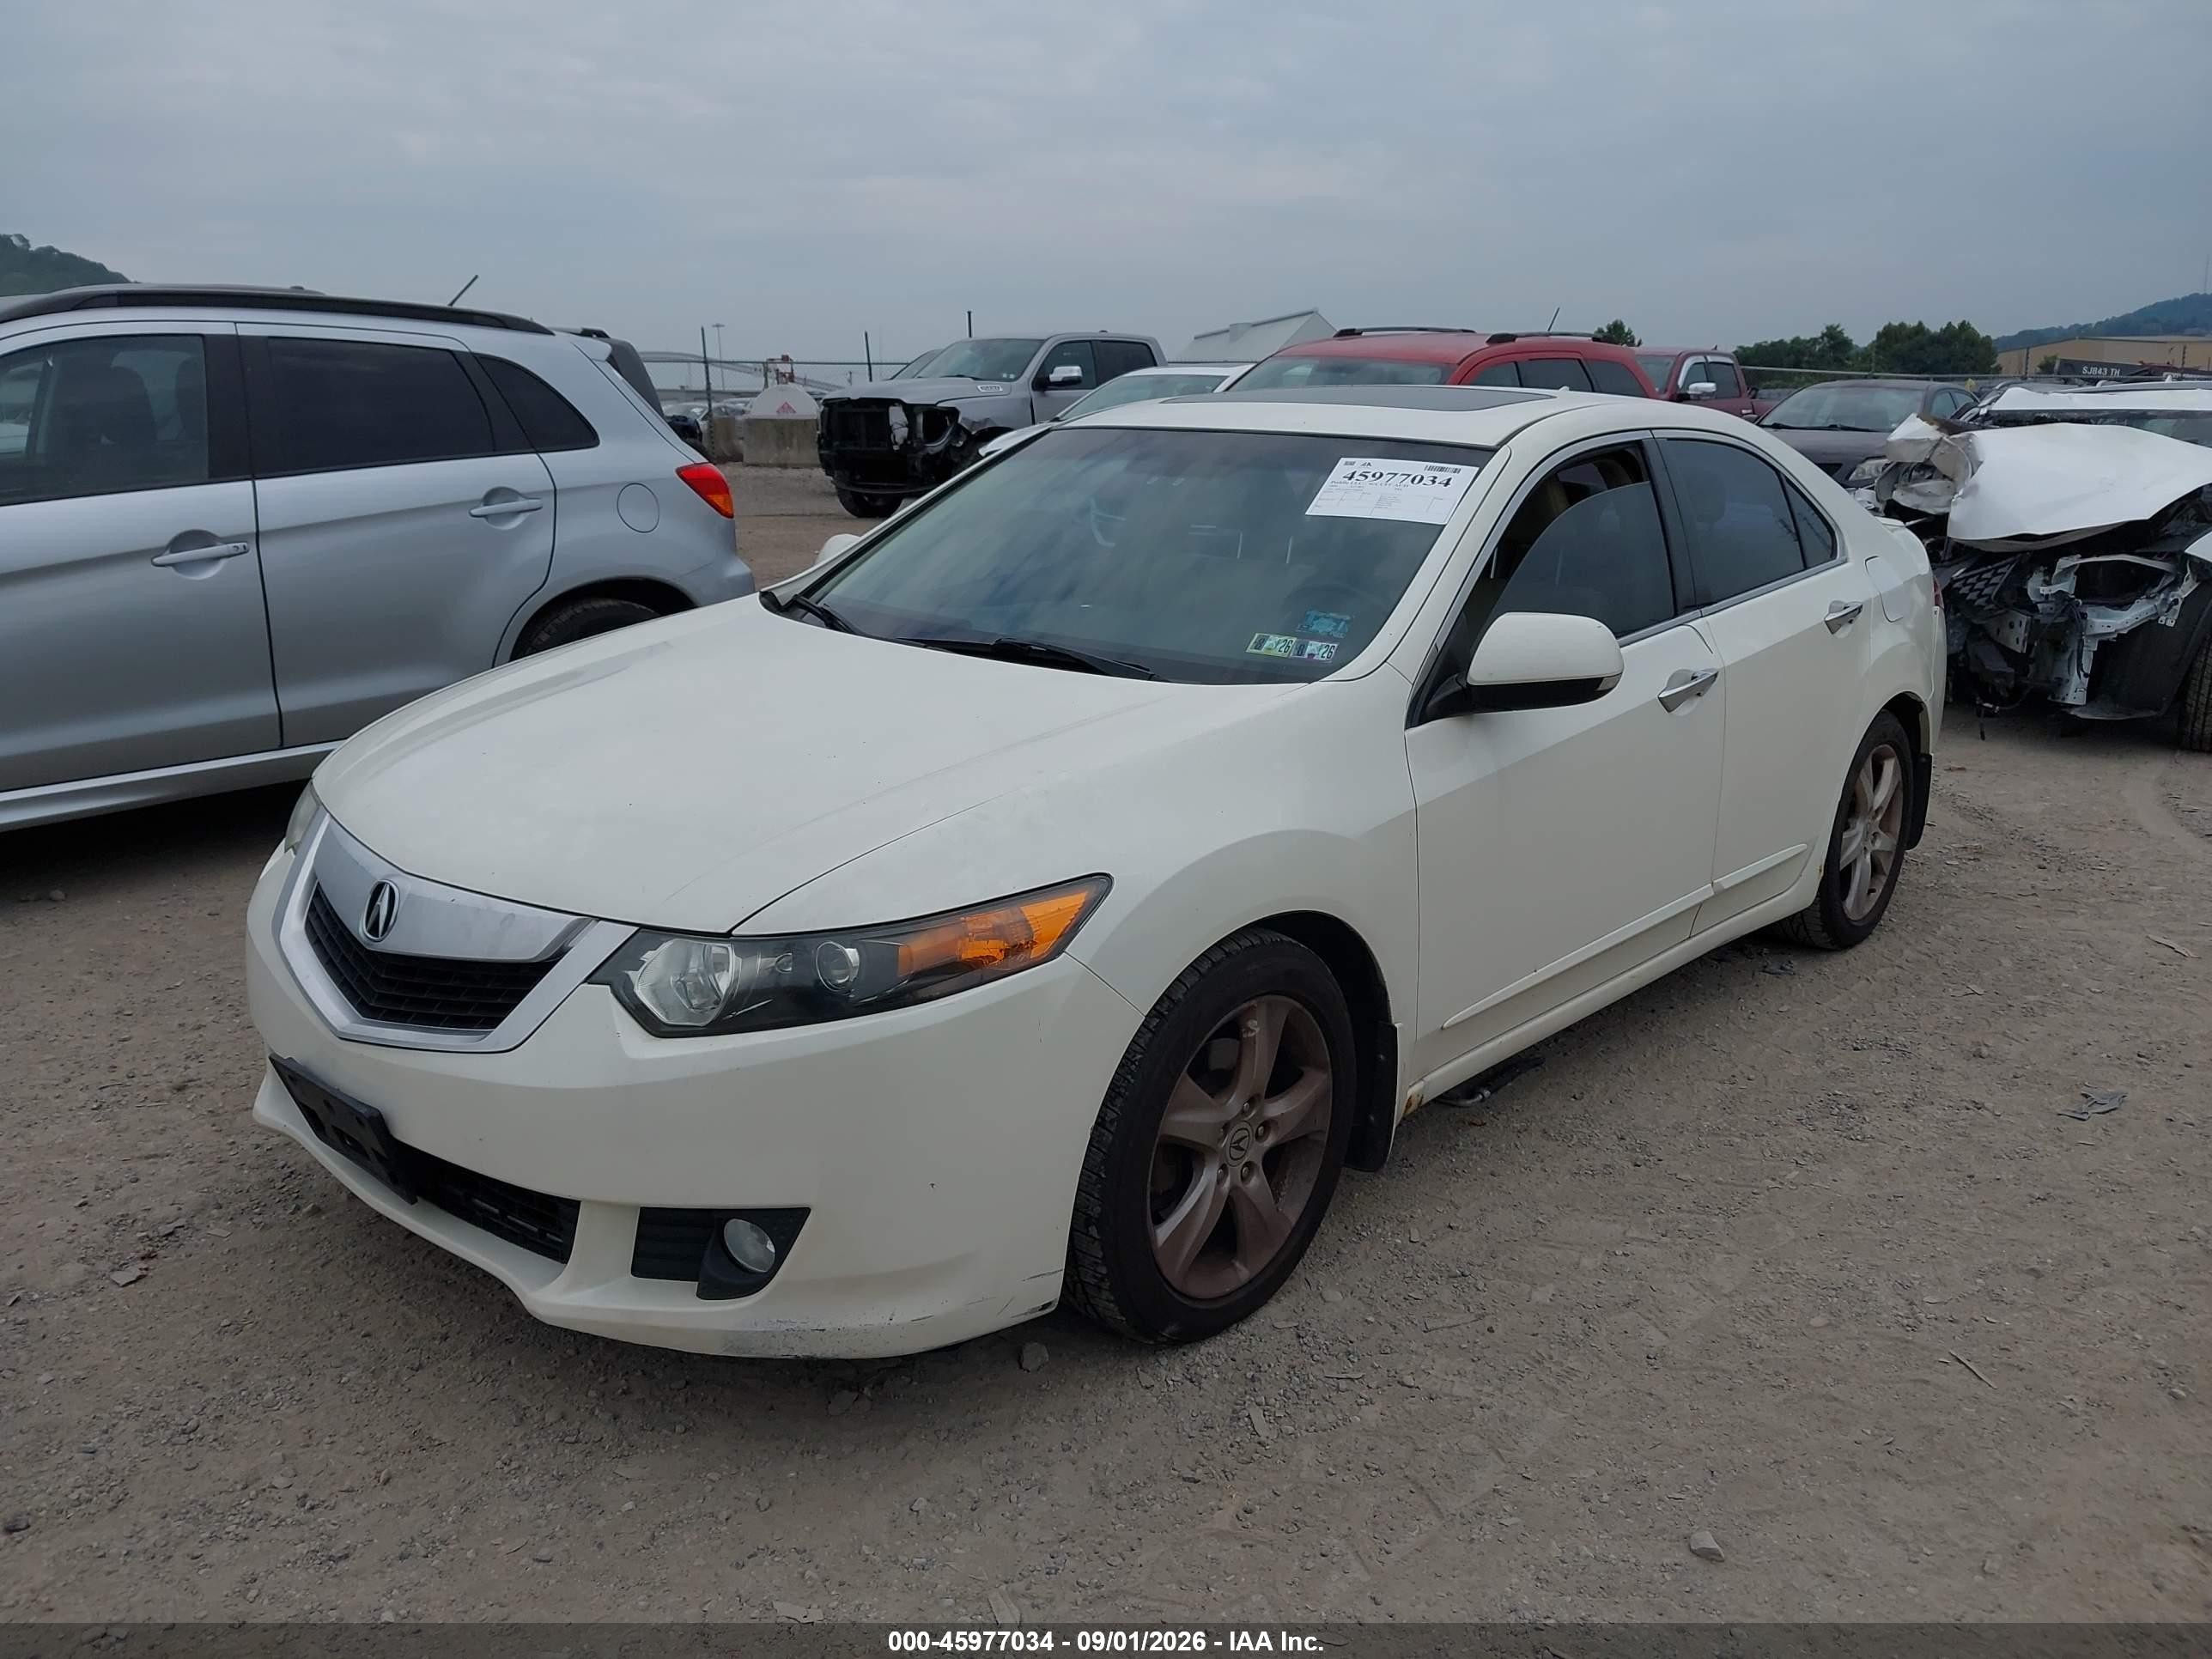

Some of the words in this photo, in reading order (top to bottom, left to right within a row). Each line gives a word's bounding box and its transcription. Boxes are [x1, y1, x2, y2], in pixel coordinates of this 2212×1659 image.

[1342, 470, 1453, 487] 45977034
[1278, 639, 1293, 653] 26
[1321, 644, 1336, 659] 26
